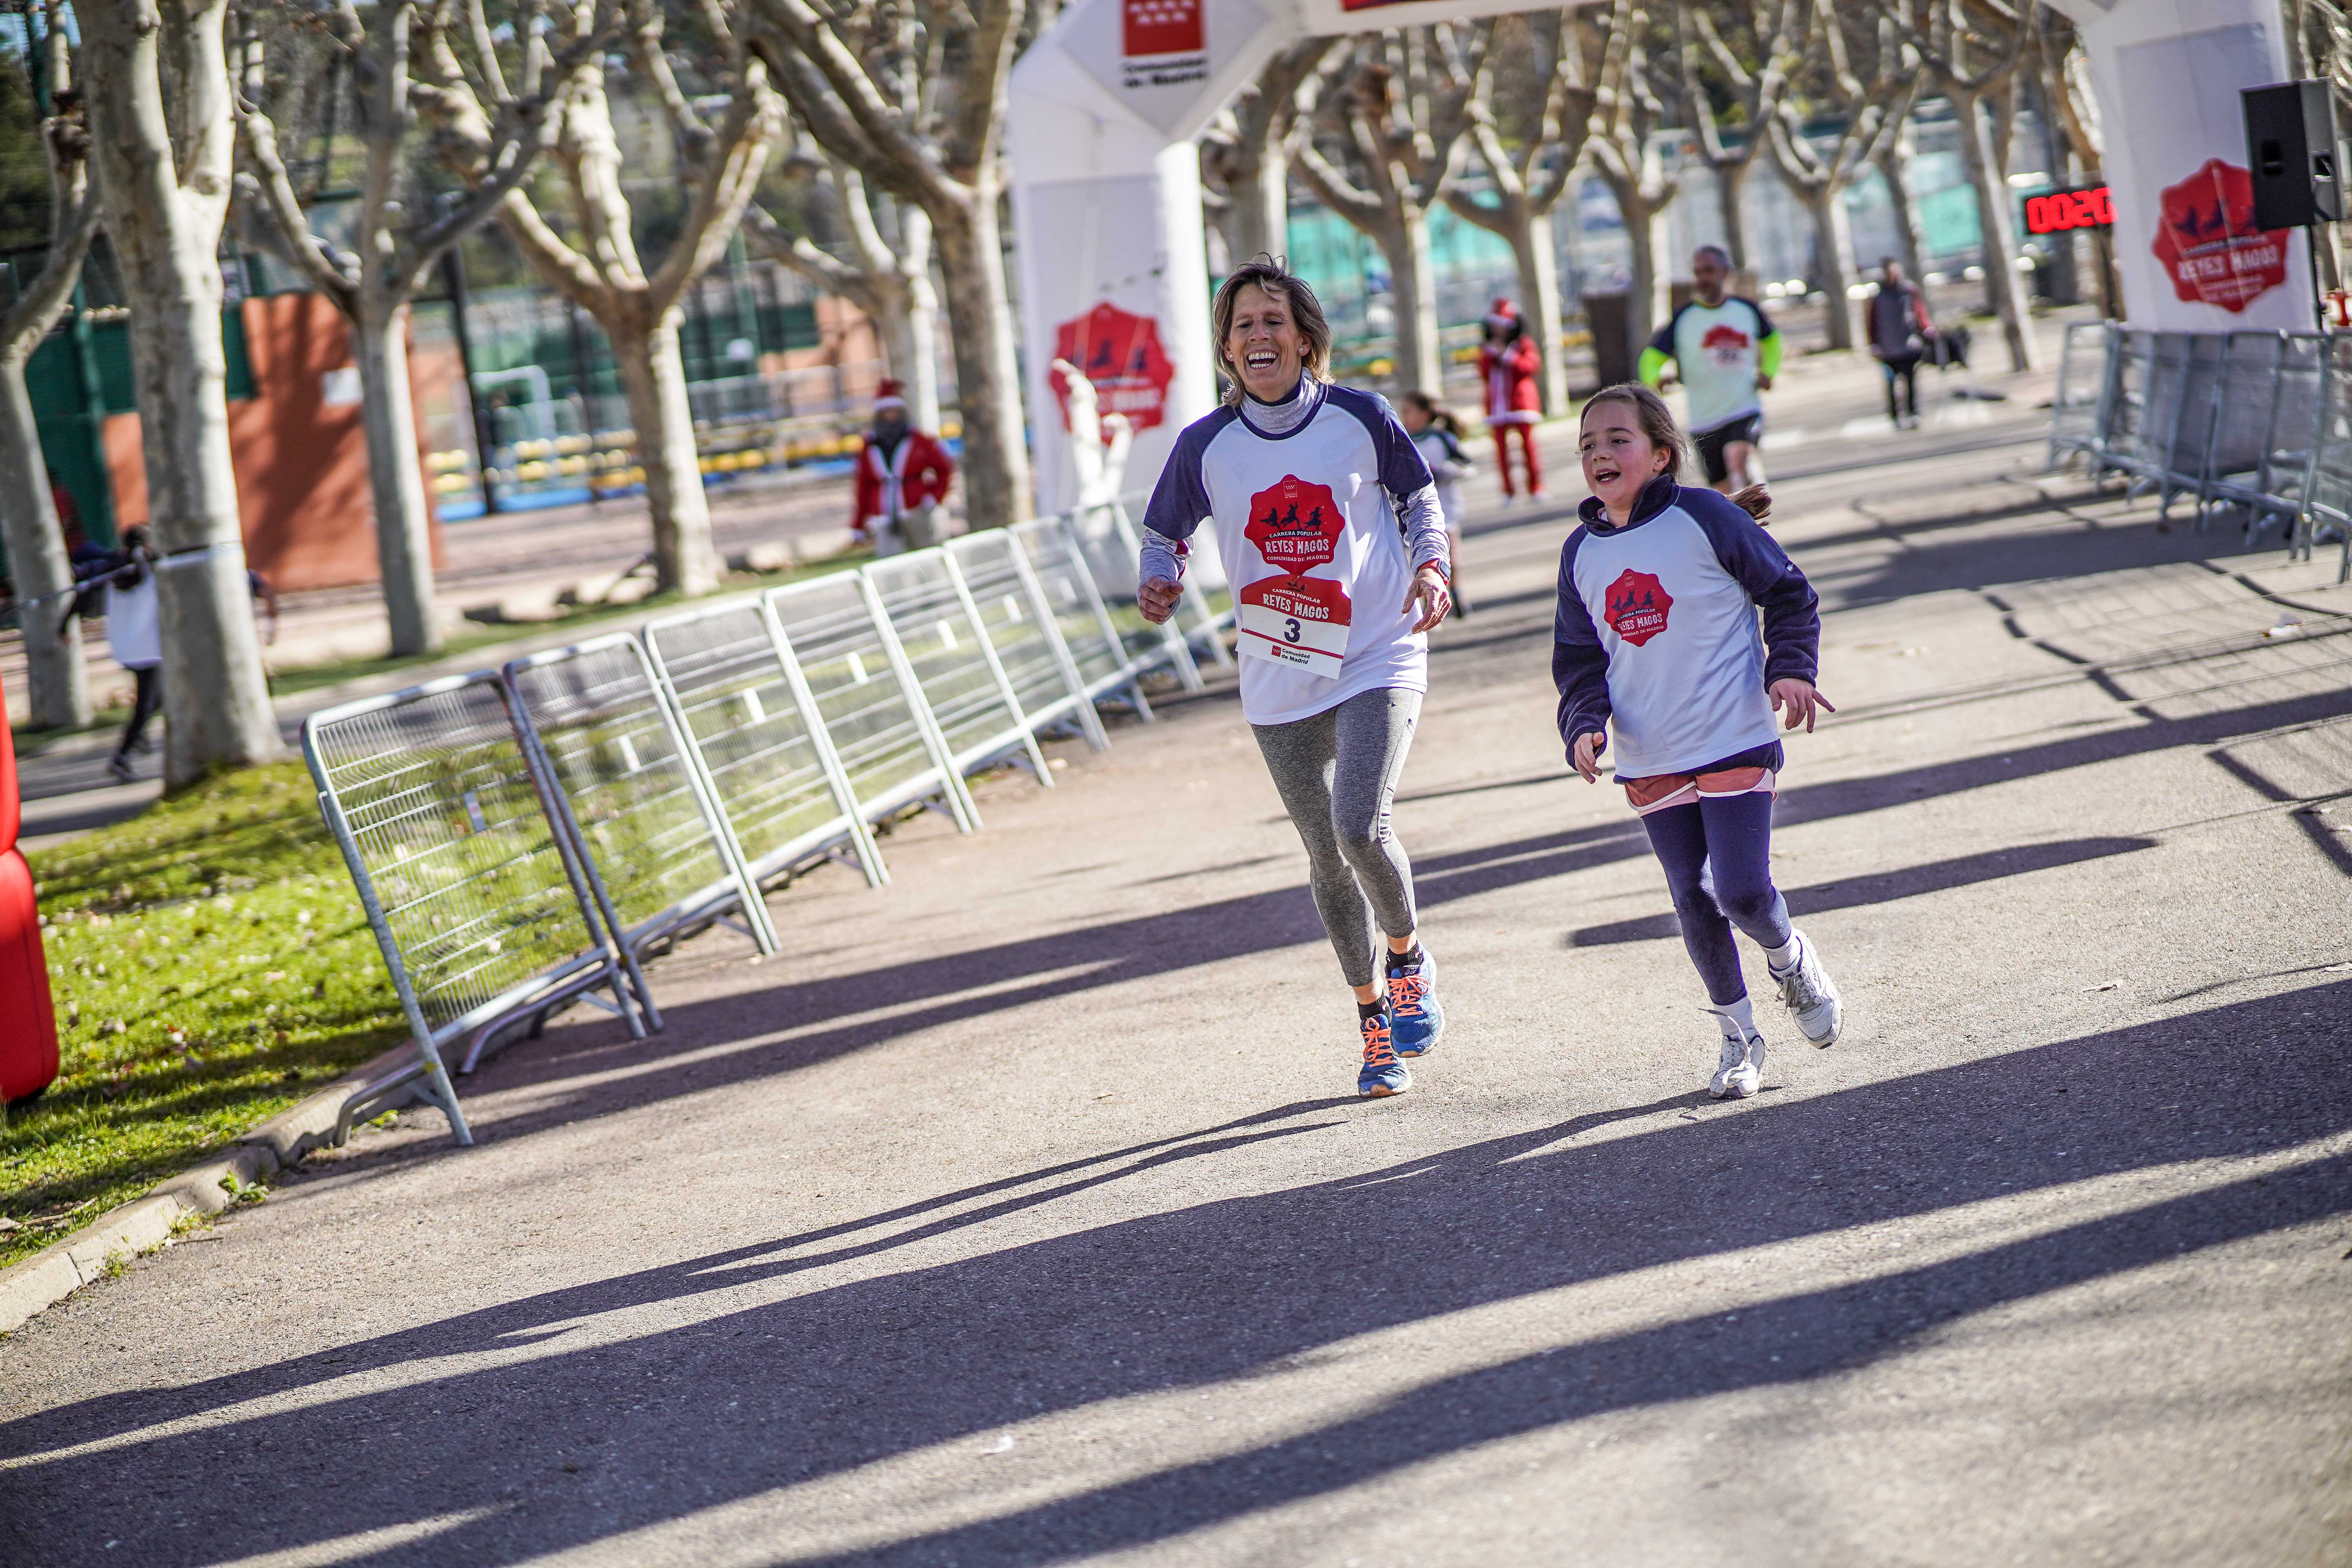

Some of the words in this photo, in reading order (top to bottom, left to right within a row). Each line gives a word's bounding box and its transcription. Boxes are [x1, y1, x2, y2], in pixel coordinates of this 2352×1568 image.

[1265, 540, 1294, 553] REYES
[1297, 539, 1329, 554] MAGOS
[1263, 593, 1291, 612] REYES
[1294, 602, 1329, 619] MAGOS
[1297, 593, 1320, 604] POPULAR
[1637, 613, 1662, 628] MAGOS
[1284, 618, 1300, 642] 3
[1282, 649, 1310, 659] Comunidad
